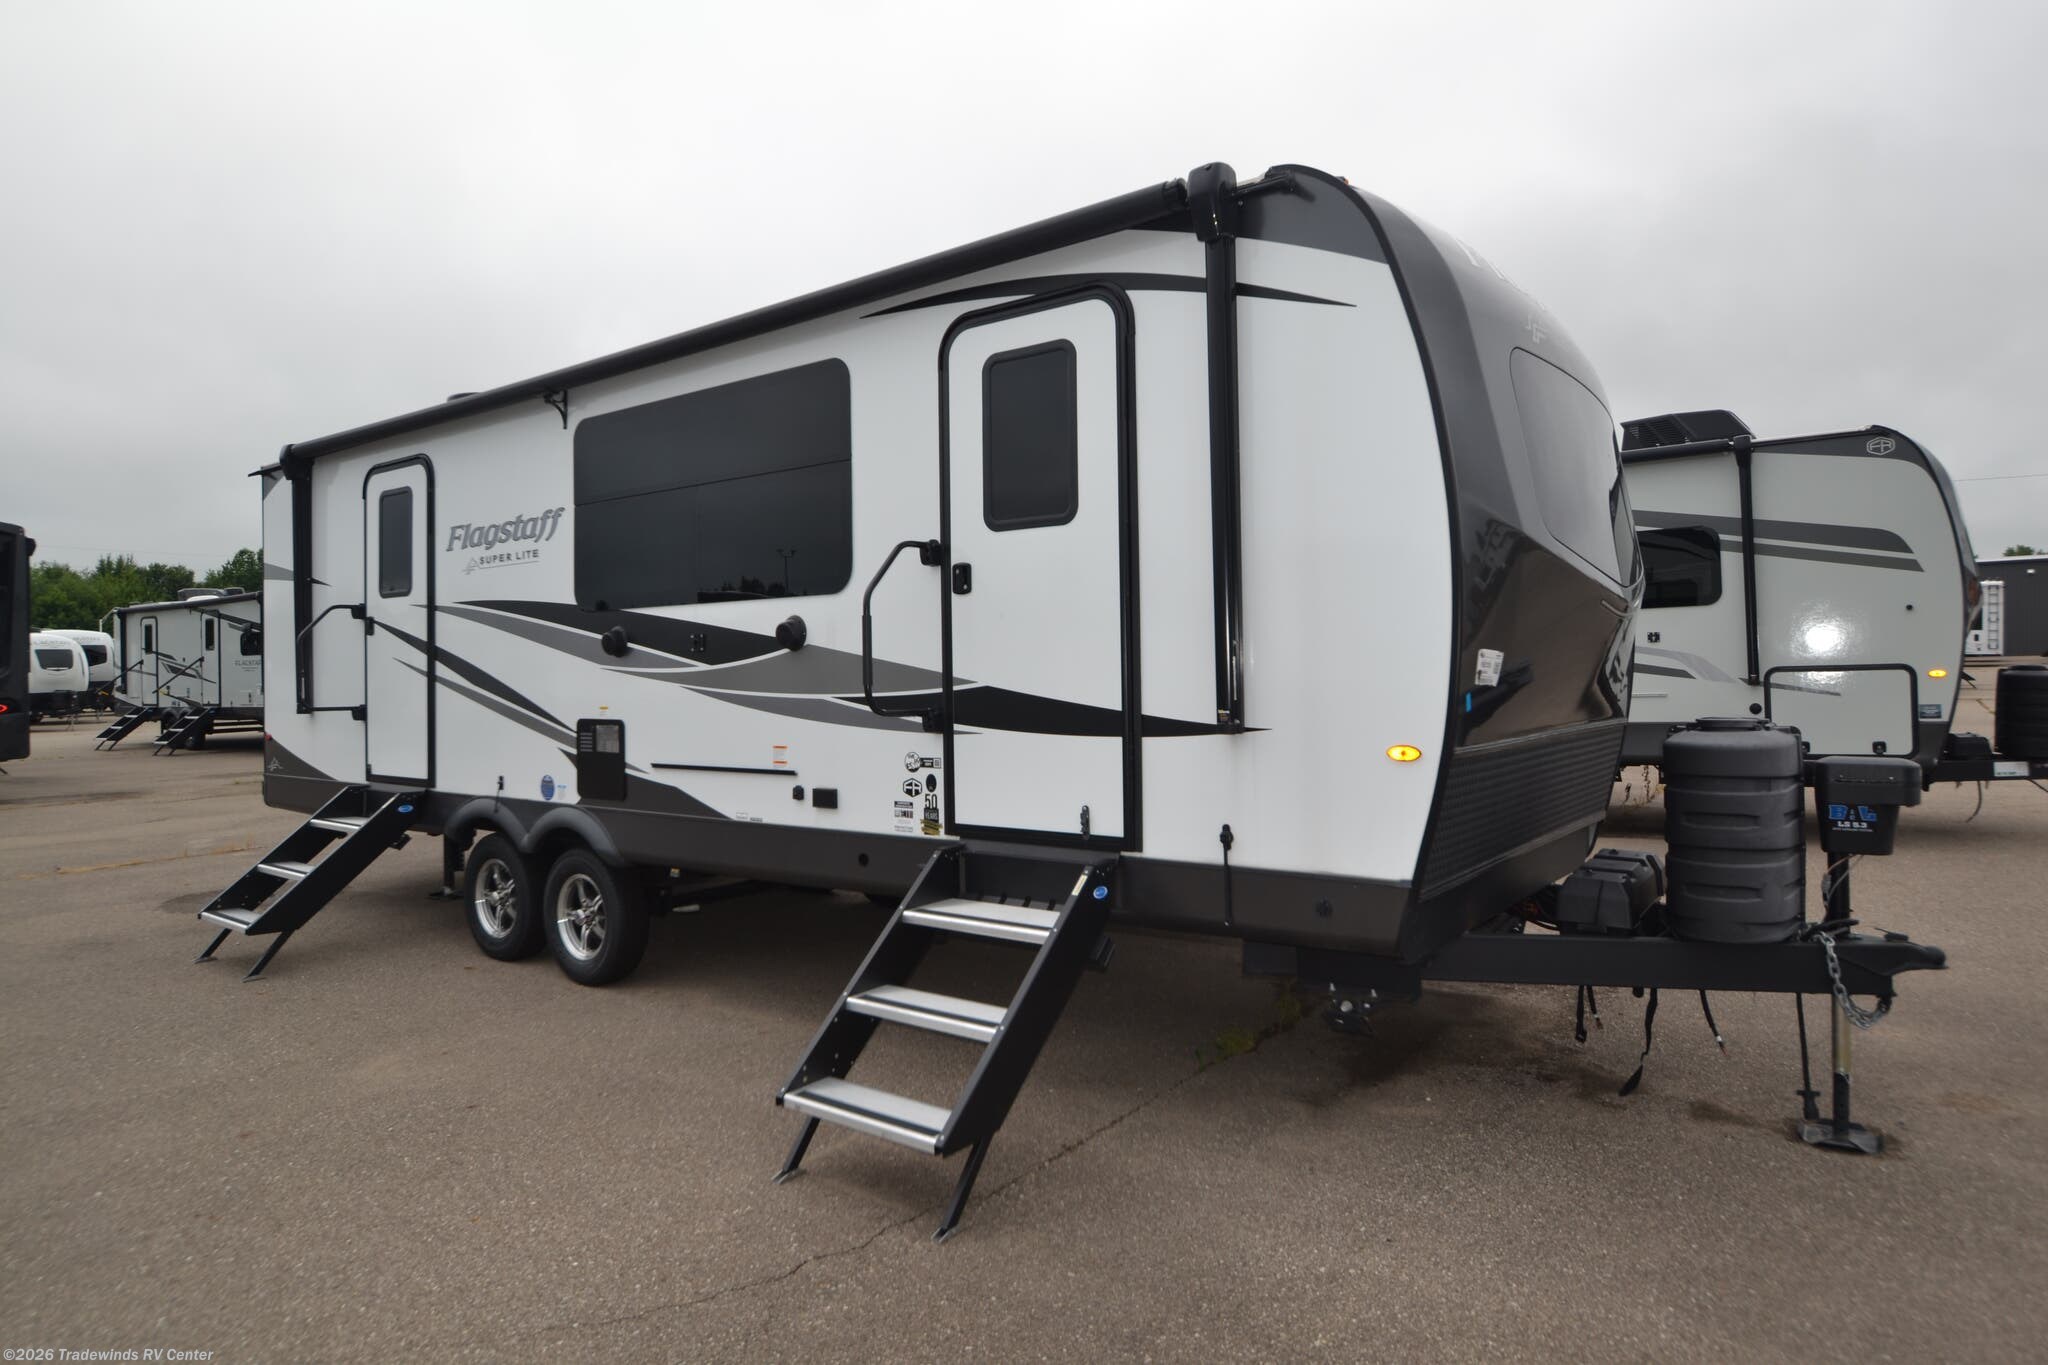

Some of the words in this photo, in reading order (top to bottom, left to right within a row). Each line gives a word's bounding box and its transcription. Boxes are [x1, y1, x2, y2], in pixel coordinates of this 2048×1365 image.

[446, 507, 565, 551] Flagstaff
[479, 553, 512, 565] SUPER
[515, 549, 540, 560] LITE
[925, 793, 938, 809] 50
